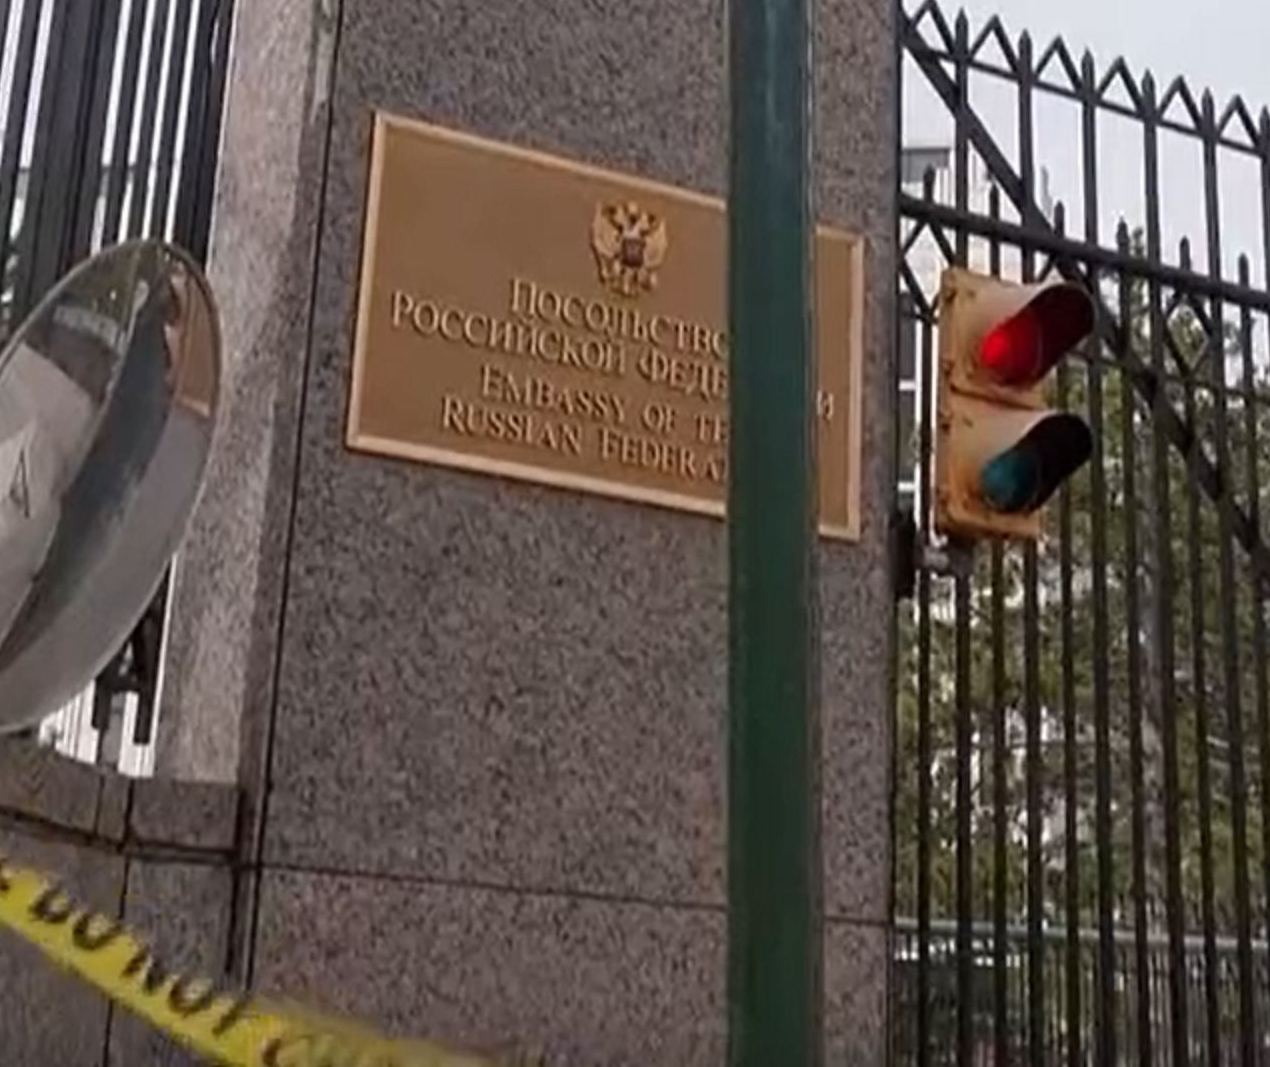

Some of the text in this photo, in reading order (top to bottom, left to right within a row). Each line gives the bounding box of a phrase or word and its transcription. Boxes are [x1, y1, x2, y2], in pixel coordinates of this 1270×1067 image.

[391, 289, 627, 376] РОССИЙСКОЙ
[442, 394, 728, 483] RUSSIAN FEDERA
[480, 363, 626, 423] EMBASSY
[641, 401, 676, 433] OF
